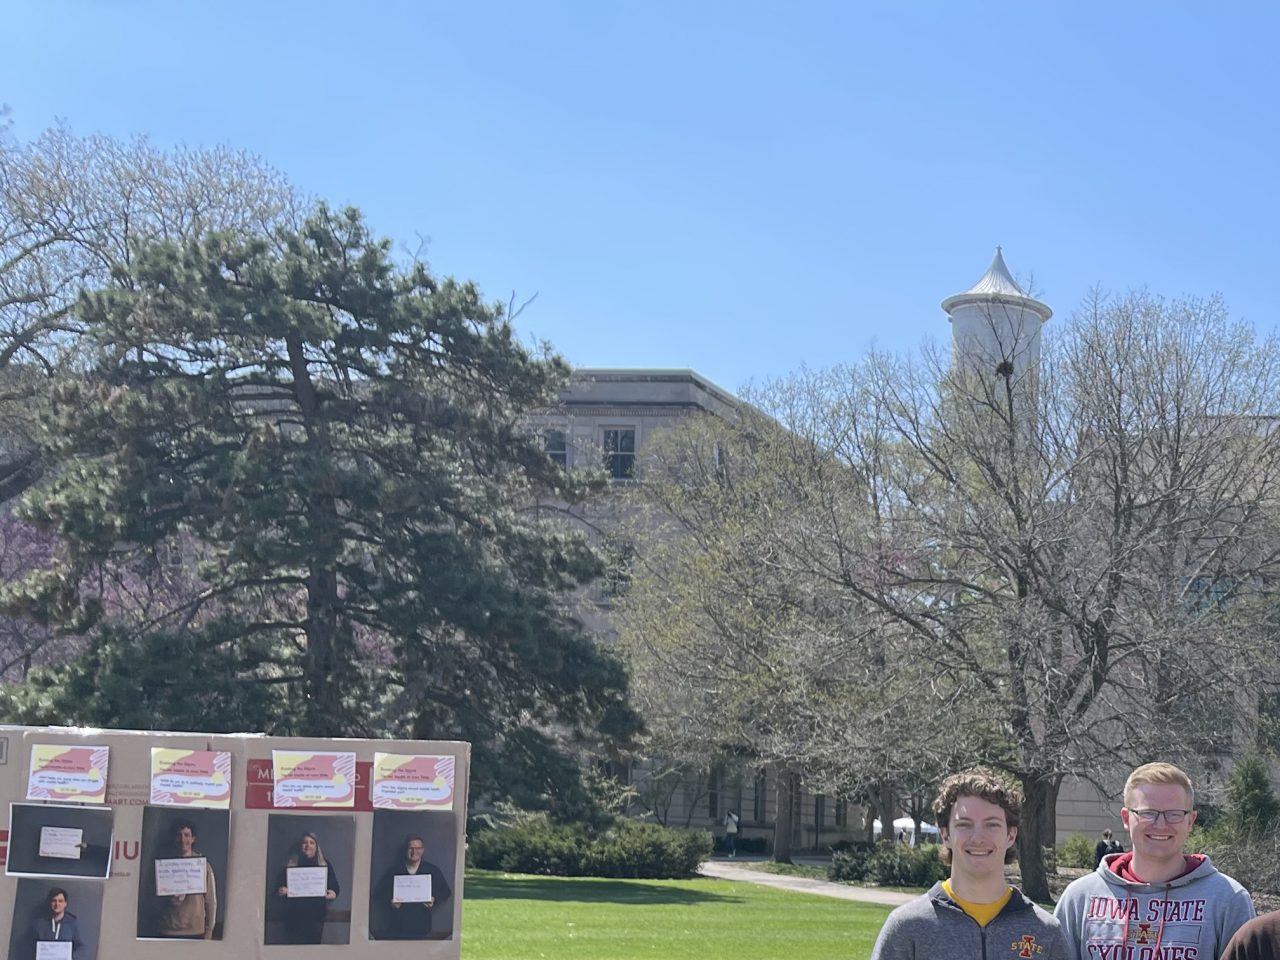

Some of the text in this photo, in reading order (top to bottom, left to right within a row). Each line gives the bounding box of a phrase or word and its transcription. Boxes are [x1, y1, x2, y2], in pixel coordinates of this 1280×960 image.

[1088, 896, 1206, 922] IOWA STATE
[1011, 941, 1043, 954] STATE
